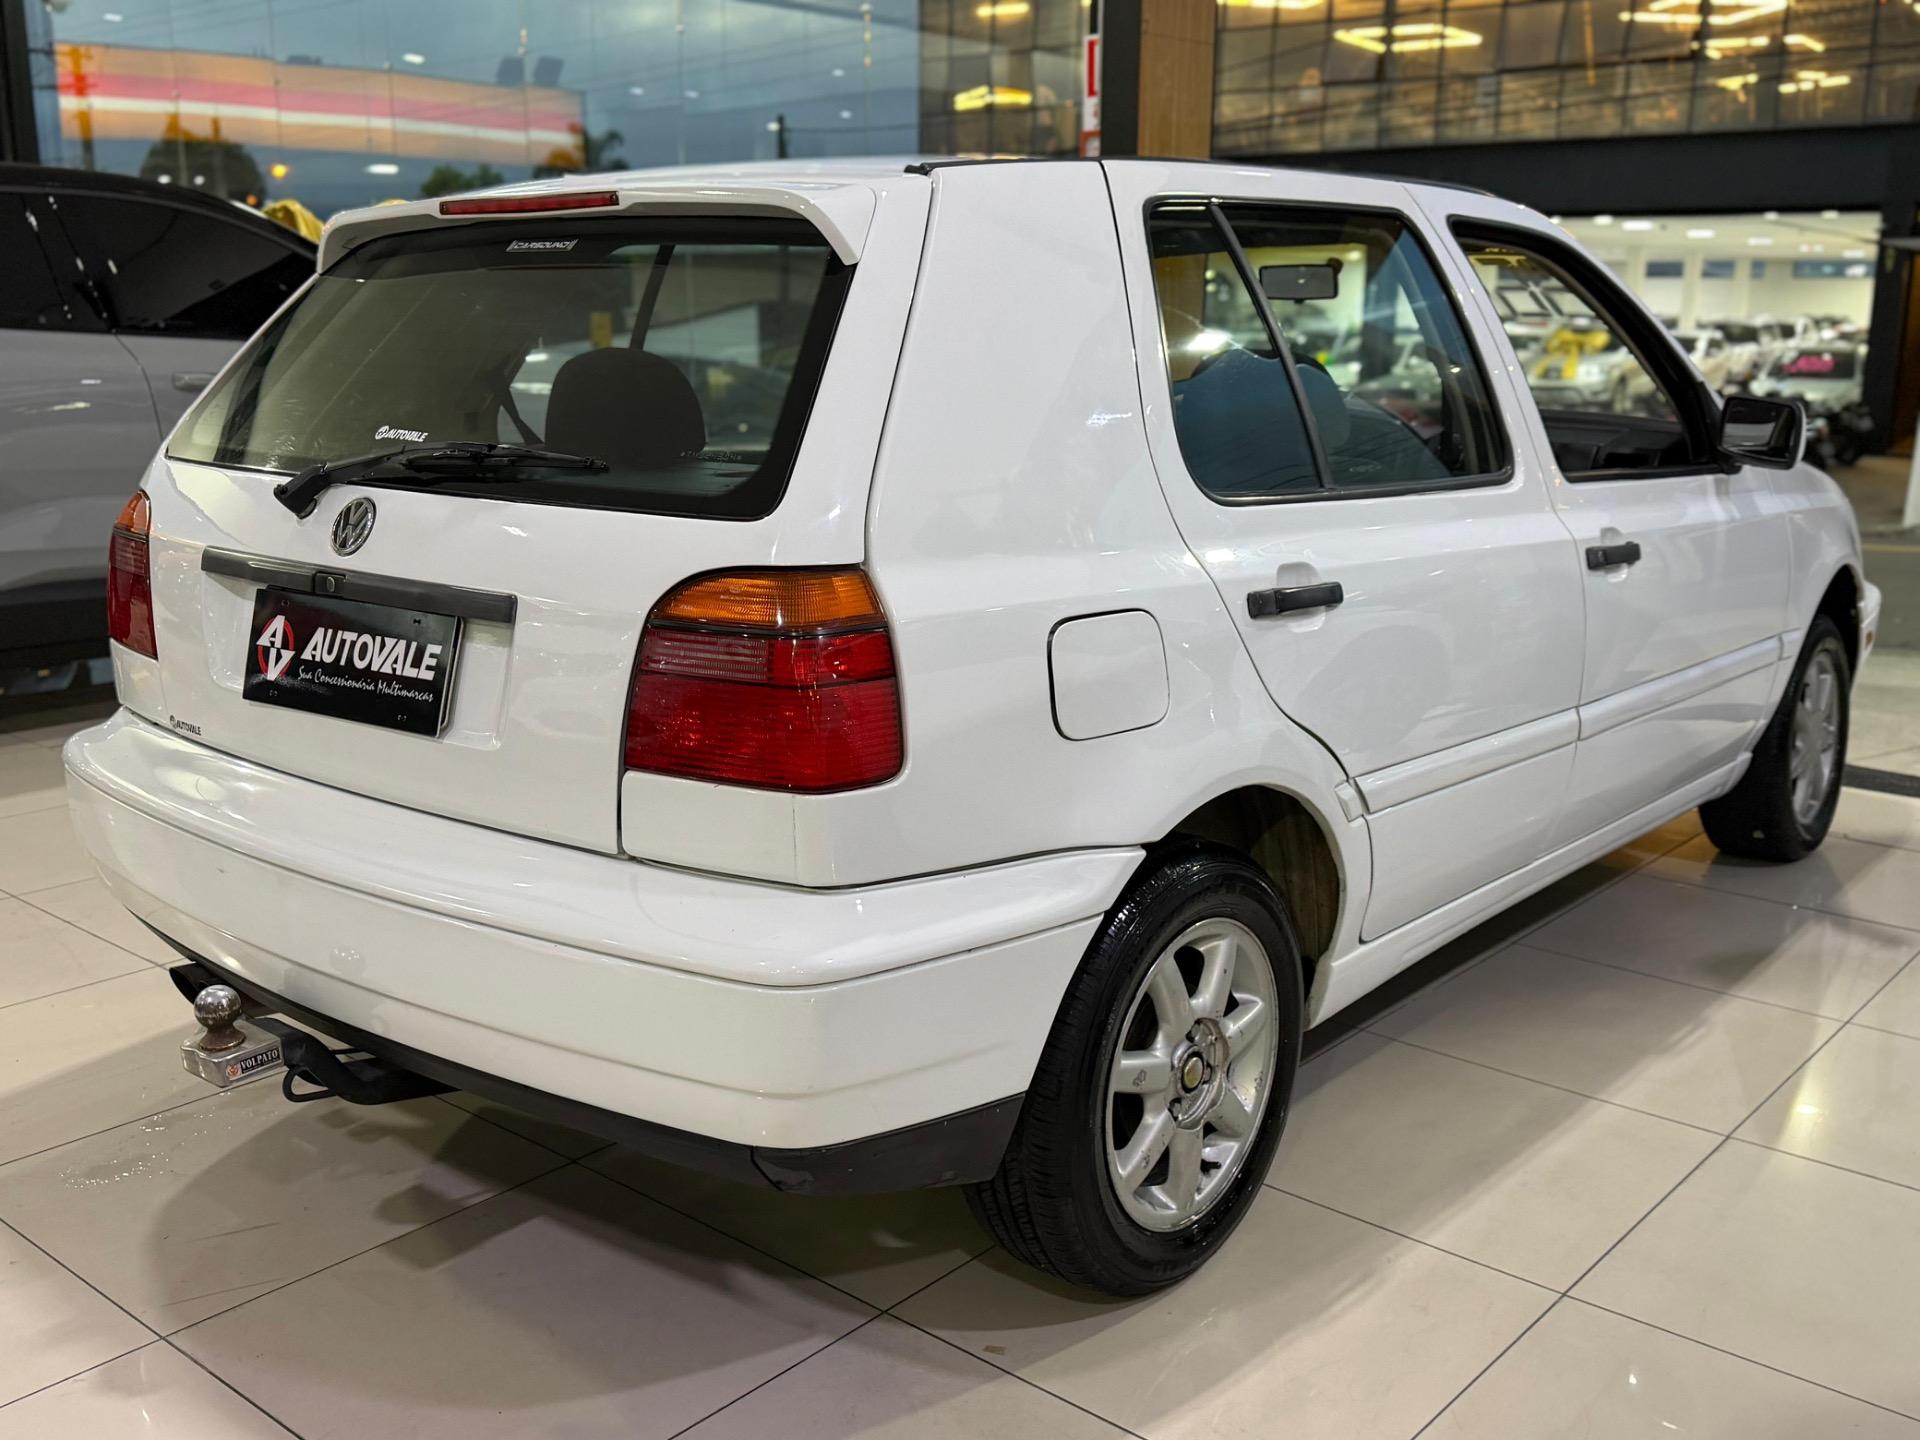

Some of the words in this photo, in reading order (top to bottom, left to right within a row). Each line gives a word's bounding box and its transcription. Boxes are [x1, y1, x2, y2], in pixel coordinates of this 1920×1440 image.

[385, 428, 429, 442] AUTOVALE
[300, 626, 443, 681] AUTOVALE
[298, 665, 313, 681] Sua
[314, 668, 375, 691] Concessionária
[376, 679, 434, 703] Multimarcas
[241, 1049, 279, 1070] VOLPATO
